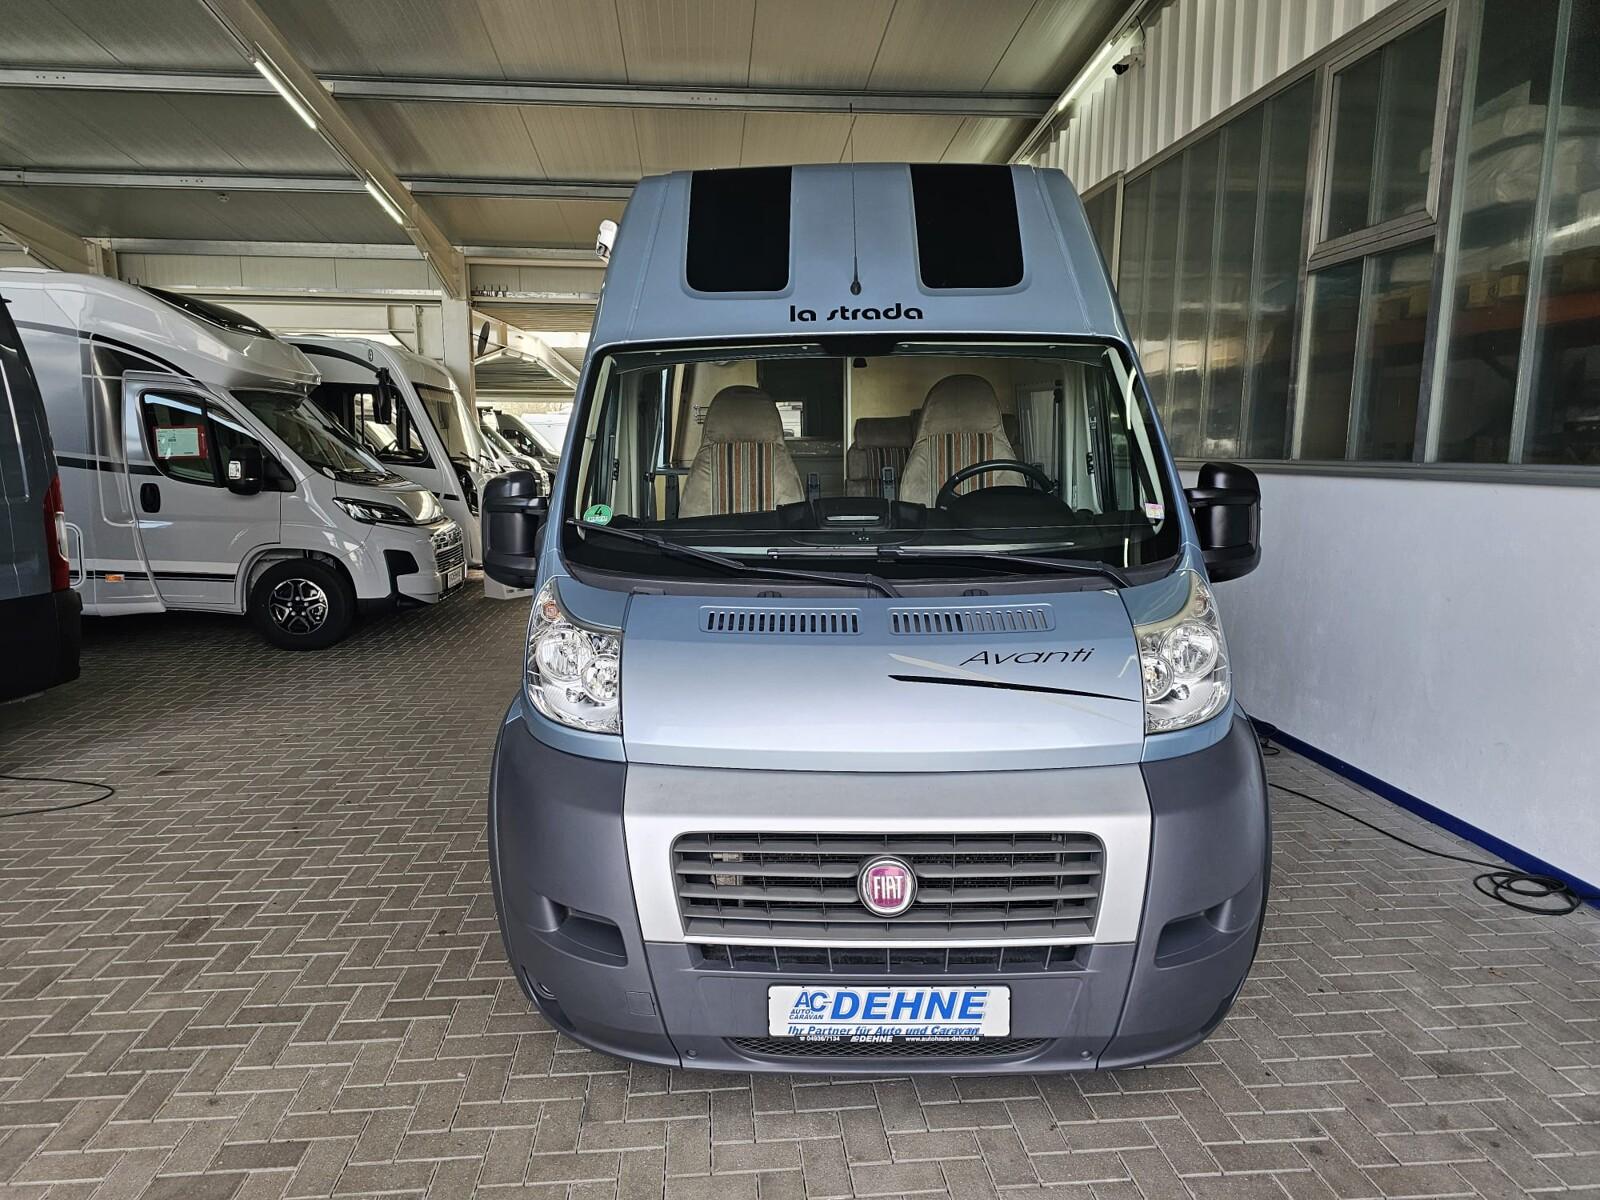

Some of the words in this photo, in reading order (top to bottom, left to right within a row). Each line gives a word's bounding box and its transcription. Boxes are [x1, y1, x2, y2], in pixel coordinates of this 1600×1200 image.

[789, 305, 817, 322] la
[826, 303, 923, 321] strada
[594, 506, 603, 516] 4
[959, 647, 1095, 667] Avanti
[873, 875, 904, 900] FIAT
[830, 991, 988, 1020] DEHNE
[788, 1026, 805, 1035] Ihr
[807, 1026, 852, 1036] Partner
[855, 1026, 872, 1036] für
[875, 1026, 902, 1036] Auto
[905, 1026, 929, 1036] und
[931, 1026, 980, 1036] Caravan
[859, 1035, 893, 1043] DEHNE
